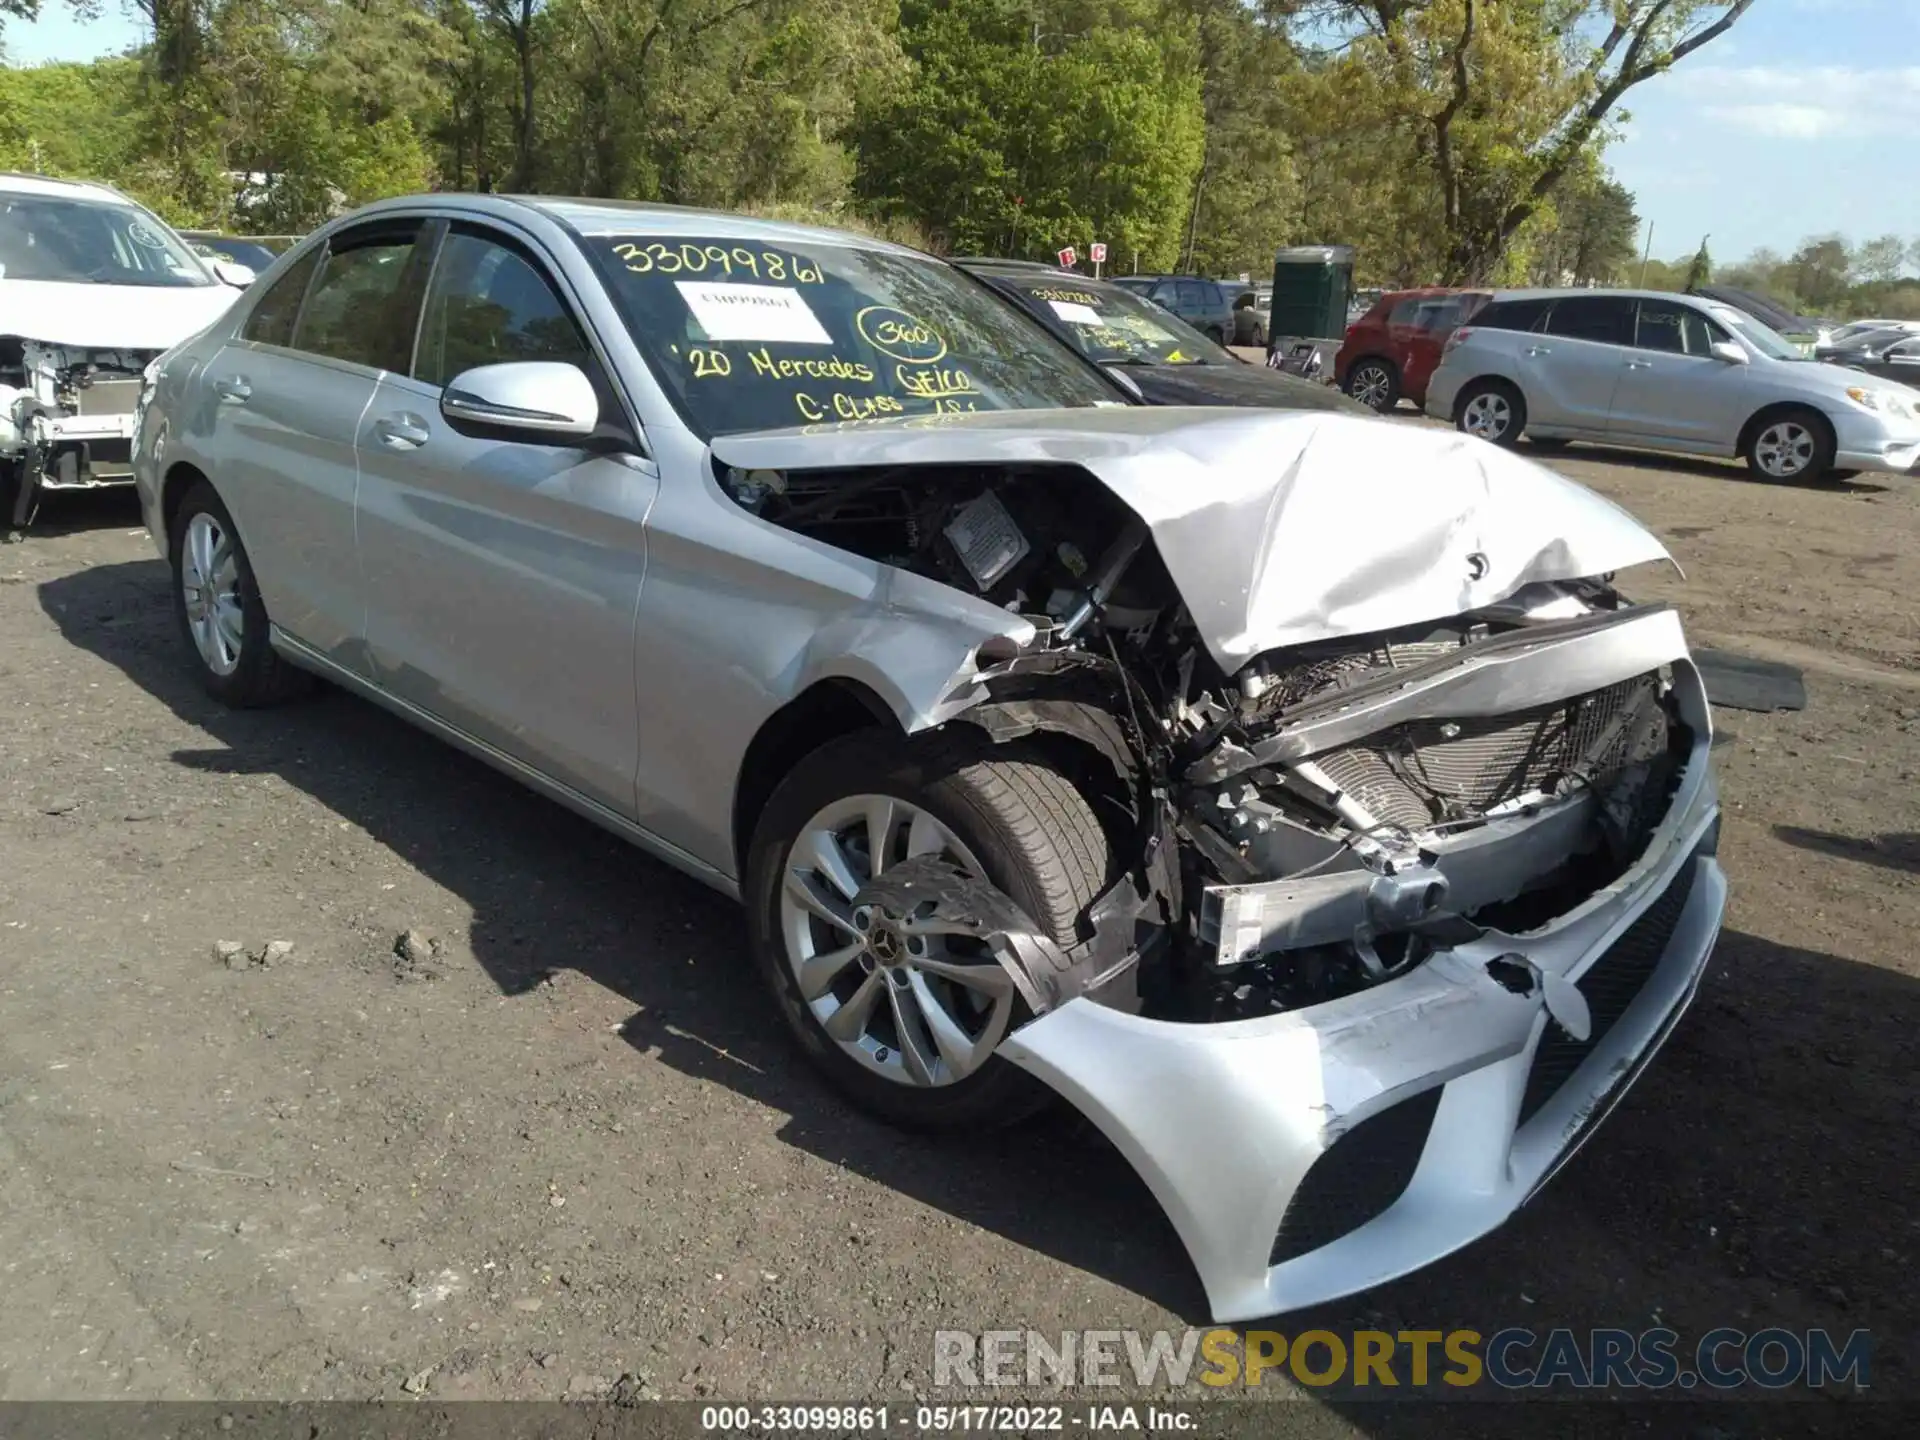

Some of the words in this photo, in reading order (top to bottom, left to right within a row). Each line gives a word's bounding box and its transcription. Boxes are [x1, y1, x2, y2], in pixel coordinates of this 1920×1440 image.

[611, 243, 825, 284] 33099861
[875, 320, 929, 345] 360
[747, 345, 874, 383] Mercedes
